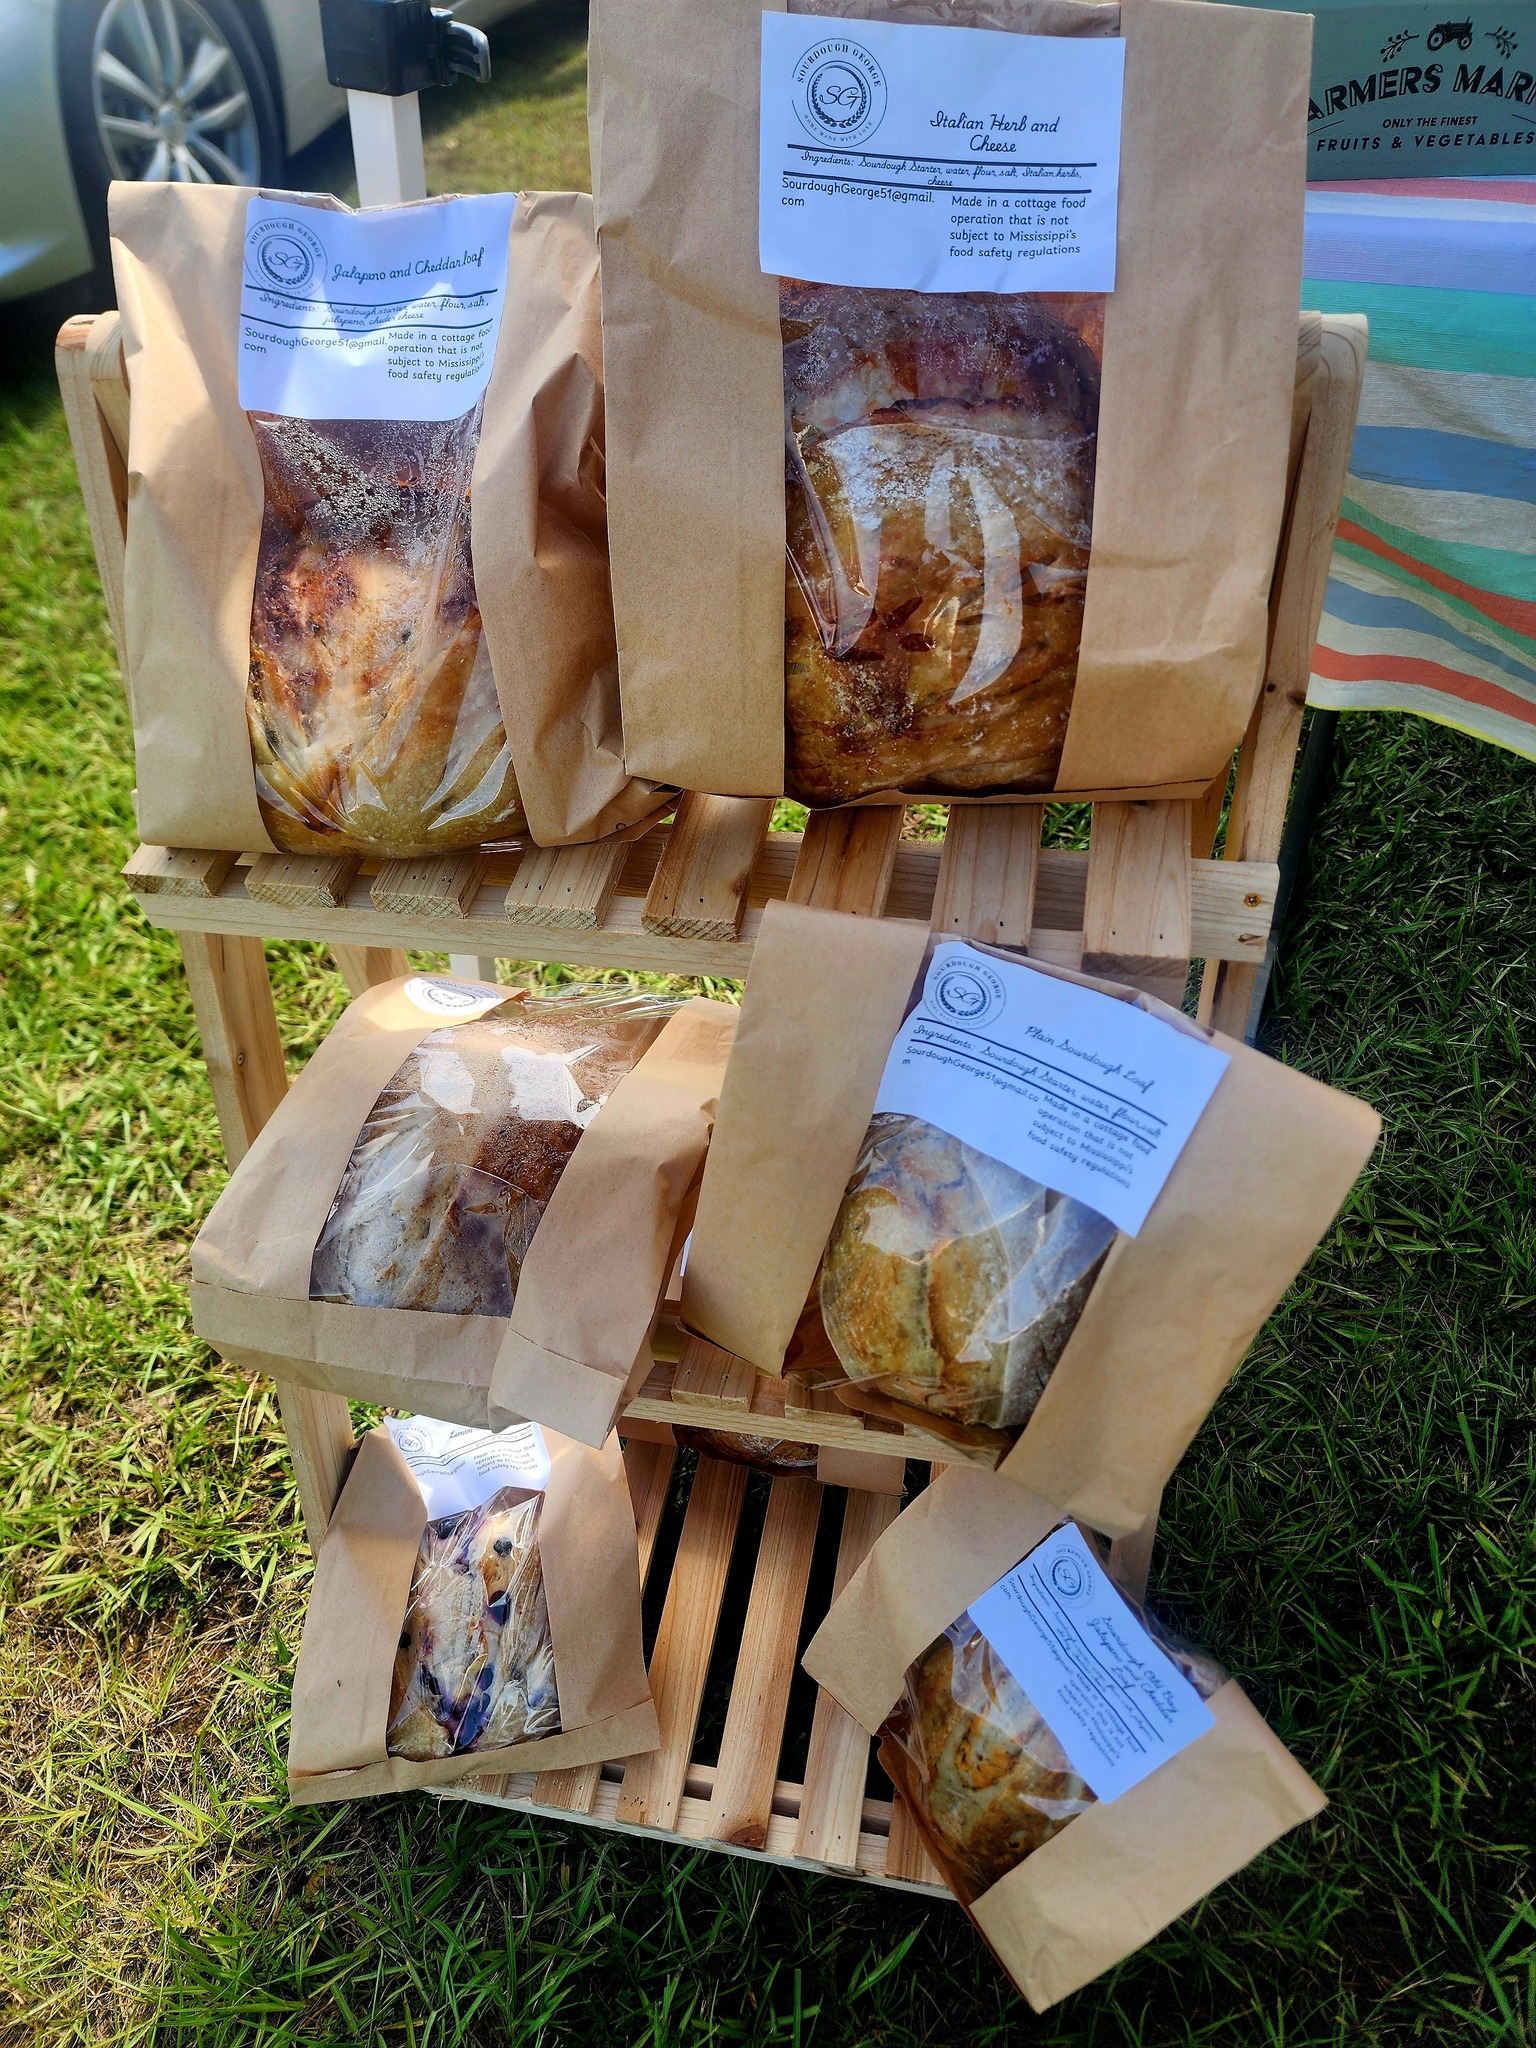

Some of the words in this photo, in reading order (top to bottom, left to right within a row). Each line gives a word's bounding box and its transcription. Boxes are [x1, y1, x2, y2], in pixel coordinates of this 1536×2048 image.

[797, 43, 849, 84] SOURDOUGH
[852, 48, 881, 87] GEORGE
[1307, 63, 1443, 122] ARMERS
[1453, 64, 1536, 106] MAR
[929, 110, 984, 131] Italian
[990, 114, 1028, 132] Herb
[1030, 116, 1061, 133] and
[1382, 118, 1413, 129] ONLY
[1417, 117, 1437, 127] THE
[1440, 115, 1478, 126] FINEST
[970, 134, 1017, 153] Cheese
[1316, 136, 1381, 152] FRUITS
[1391, 136, 1402, 149] &
[1415, 131, 1535, 148] VEGETABLES
[801, 150, 855, 166] Ingredients:
[858, 156, 907, 174] Sourdough
[908, 161, 943, 175] Starter,
[946, 166, 971, 177] water,
[972, 165, 997, 179] flour,
[1022, 166, 1054, 178] Italian
[1054, 167, 1082, 179] herbs,
[782, 177, 935, 203] SourdoughGeorge51@gmail.
[927, 176, 953, 187] cheese
[781, 197, 805, 207] com
[951, 195, 982, 207] Made
[987, 196, 997, 208] in
[1002, 199, 1010, 208] a
[1014, 198, 1057, 212] cottage
[1061, 197, 1087, 209] food
[950, 214, 1004, 227] operation
[1009, 214, 1032, 226] that
[1037, 214, 1046, 226] is
[1050, 215, 1069, 226] not
[250, 222, 294, 245] SOURDOUGH
[297, 228, 322, 259] GEORGE
[950, 229, 989, 243] subject
[993, 231, 1005, 242] to
[1009, 229, 1077, 243] Mississippi's
[950, 246, 973, 257] food
[978, 246, 1012, 260] safety
[1017, 245, 1080, 260] regulations
[389, 263, 411, 279] and
[260, 292, 319, 312] Ingredients:
[324, 303, 377, 319] Sourdough
[440, 297, 466, 311] flour,
[244, 327, 387, 350] SourdoughGeorge51@gmail.
[388, 331, 414, 340] Made
[418, 331, 426, 341] in
[431, 333, 437, 341] a
[441, 332, 475, 344] cottage
[244, 342, 267, 354] com
[388, 344, 433, 355] operation
[437, 345, 457, 355] that
[460, 345, 467, 354] is
[470, 342, 483, 352] not
[388, 357, 421, 368] subject
[425, 358, 434, 367] to
[388, 369, 409, 379] food
[412, 369, 442, 383] safety
[913, 1024, 976, 1050] Ingredients:
[979, 1046, 1038, 1076] Sourdough
[1024, 1025, 1055, 1045] Plain
[1056, 1039, 1123, 1075] Sourdough
[1122, 1069, 1155, 1094] Loaf
[1043, 1094, 1068, 1113] Made
[1071, 1105, 1080, 1118] in
[1083, 1115, 1090, 1123] a
[1093, 1119, 1129, 1142] cottage
[1032, 1119, 1064, 1139] subject
[1067, 1135, 1077, 1146] to
[1038, 1108, 1081, 1134] operation
[1084, 1130, 1104, 1145] that
[1106, 1140, 1116, 1150] is
[1118, 1147, 1134, 1160] not
[1027, 1130, 1047, 1146] food
[1050, 1143, 1079, 1163] safety
[1081, 1156, 1130, 1188] regulations
[449, 1428, 473, 1439] Lemon
[1000, 1584, 1012, 1600] com
